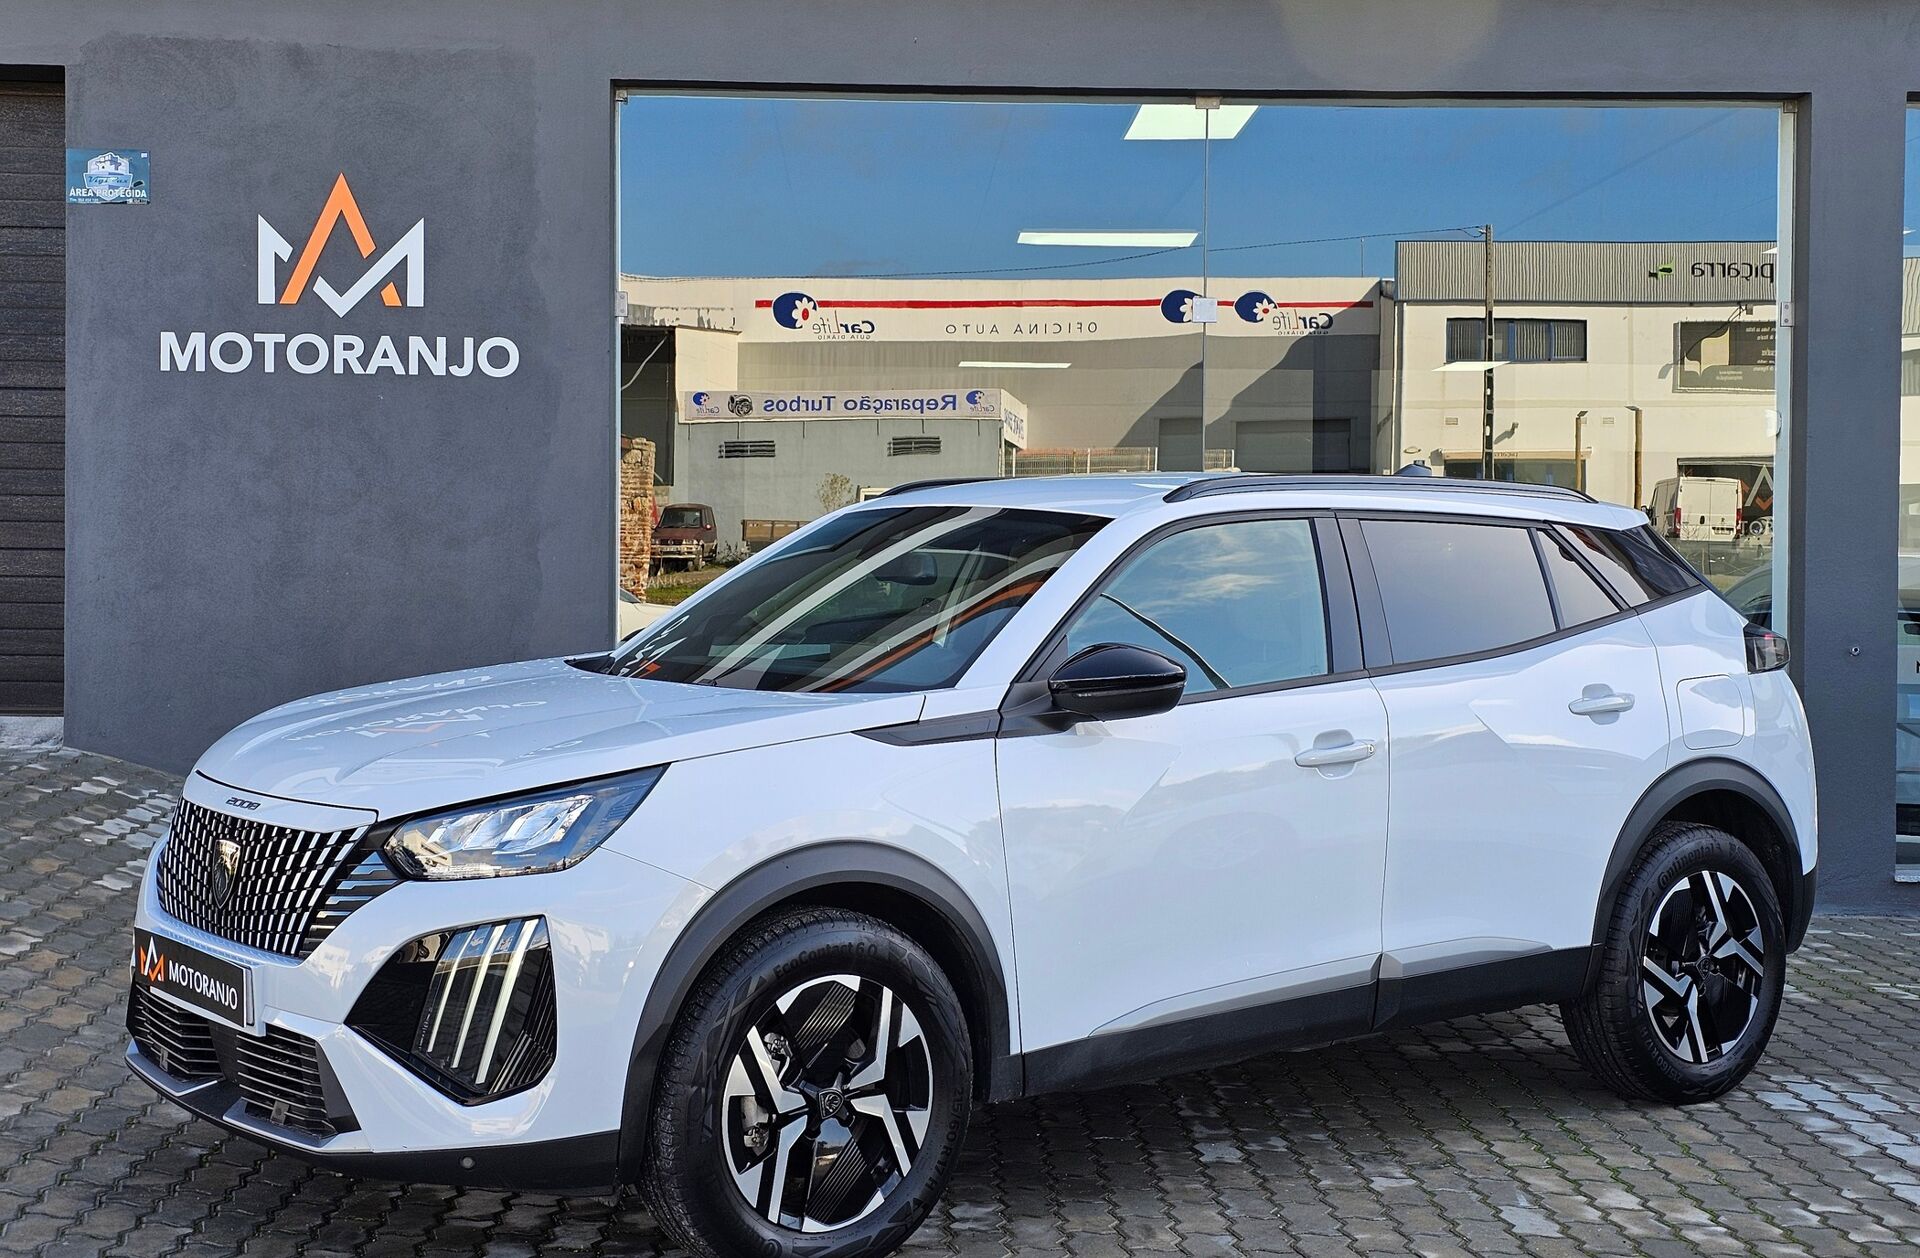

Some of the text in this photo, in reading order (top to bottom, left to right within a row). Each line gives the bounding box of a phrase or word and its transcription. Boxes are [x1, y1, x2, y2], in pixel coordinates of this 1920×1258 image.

[69, 186, 147, 198] ÁREA PROTEGIDA
[159, 331, 519, 378] MOTORANJO
[225, 796, 261, 811] 2008
[772, 941, 854, 979] EcoContact
[168, 959, 238, 1010] MOTORANJO
